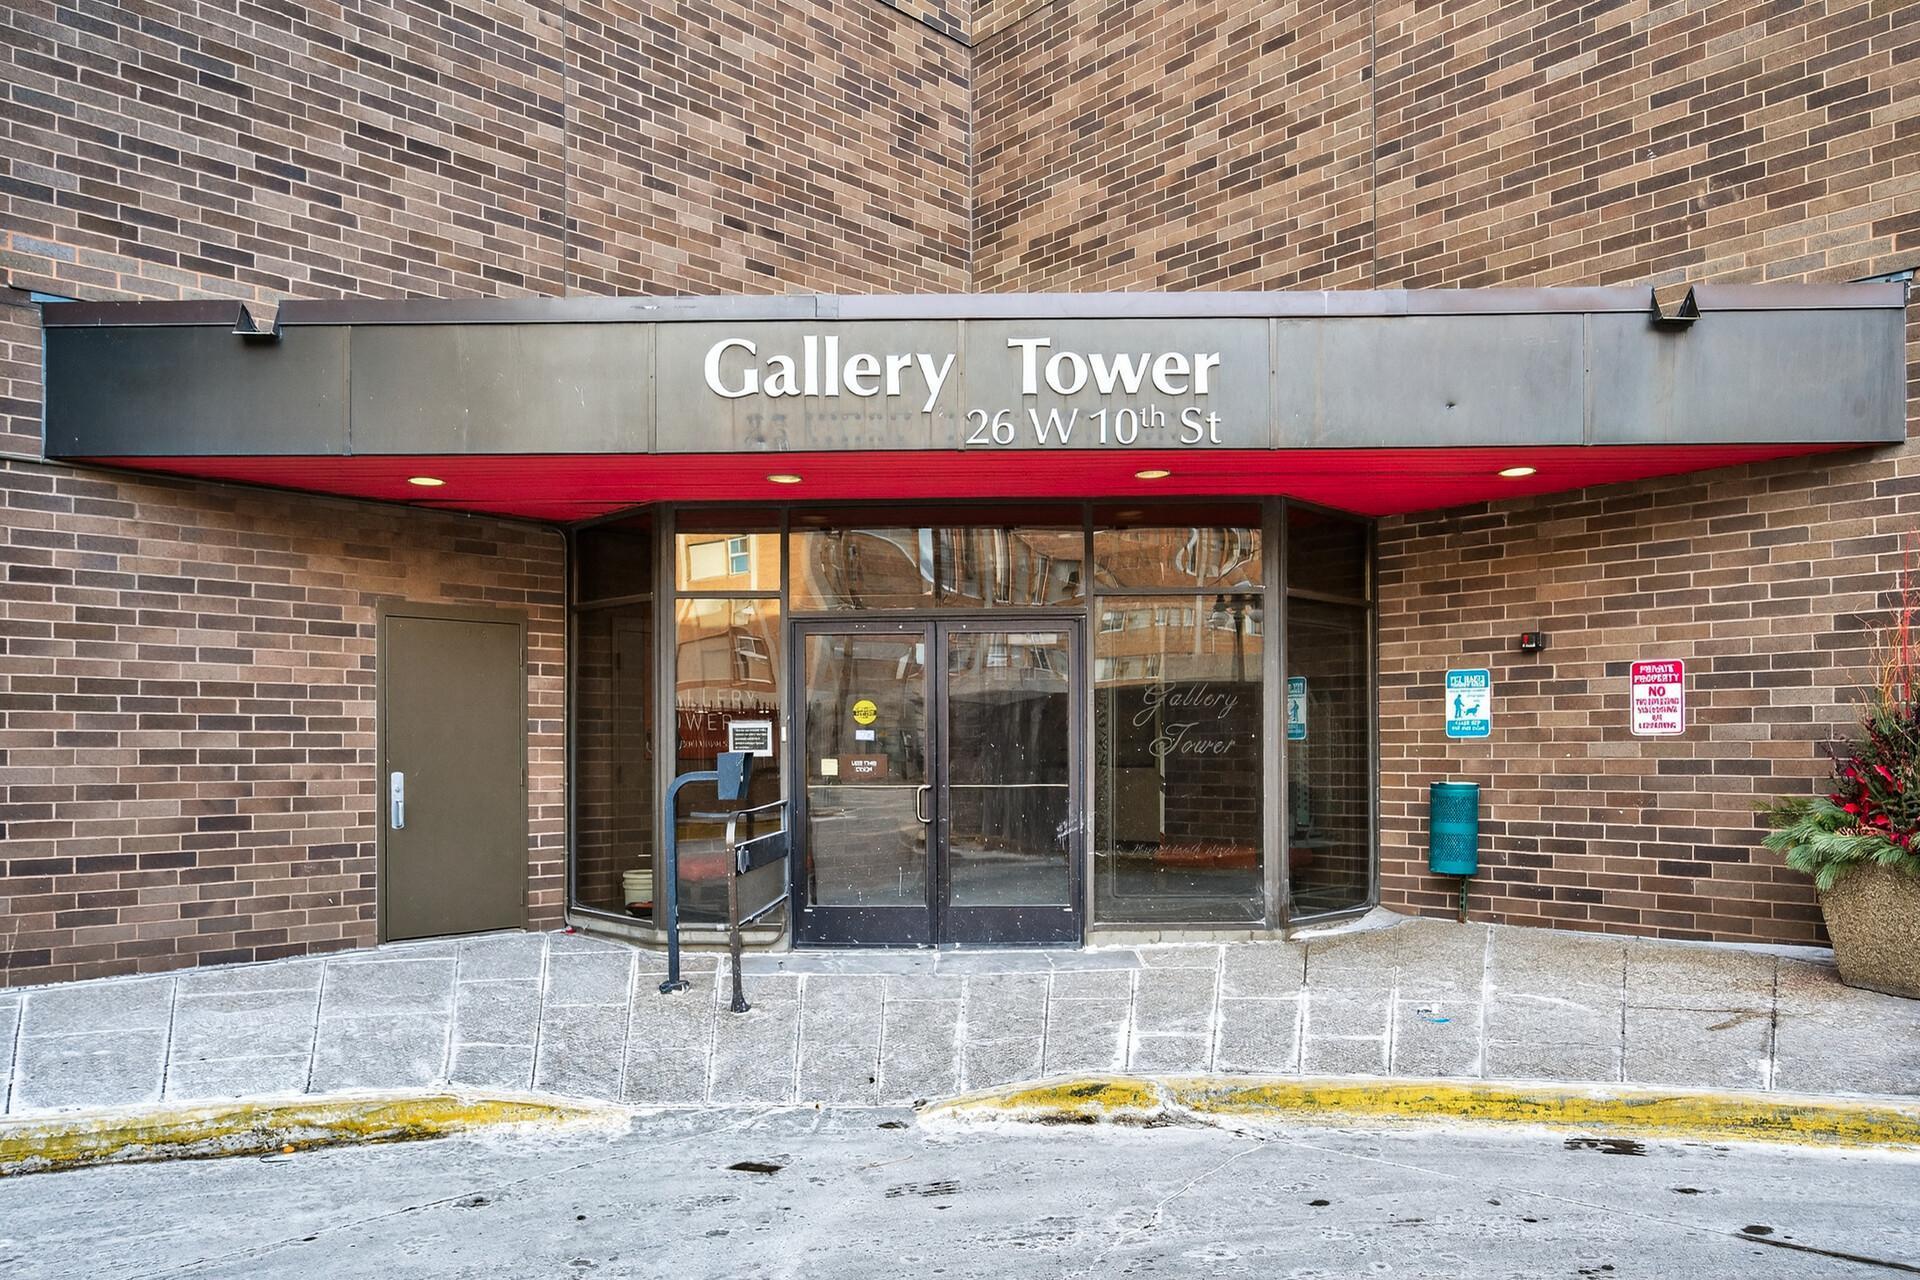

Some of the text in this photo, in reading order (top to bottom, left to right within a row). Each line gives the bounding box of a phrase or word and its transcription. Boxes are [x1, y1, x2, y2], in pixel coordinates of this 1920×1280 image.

[703, 335, 1221, 413] Gallery Tower
[965, 403, 1222, 445] 26 W 10th St
[1633, 673, 1680, 683] PROPERTY
[1648, 686, 1666, 697] NO
[1133, 680, 1239, 727] Gallery
[677, 713, 733, 731] WER
[1148, 722, 1236, 758] Tower
